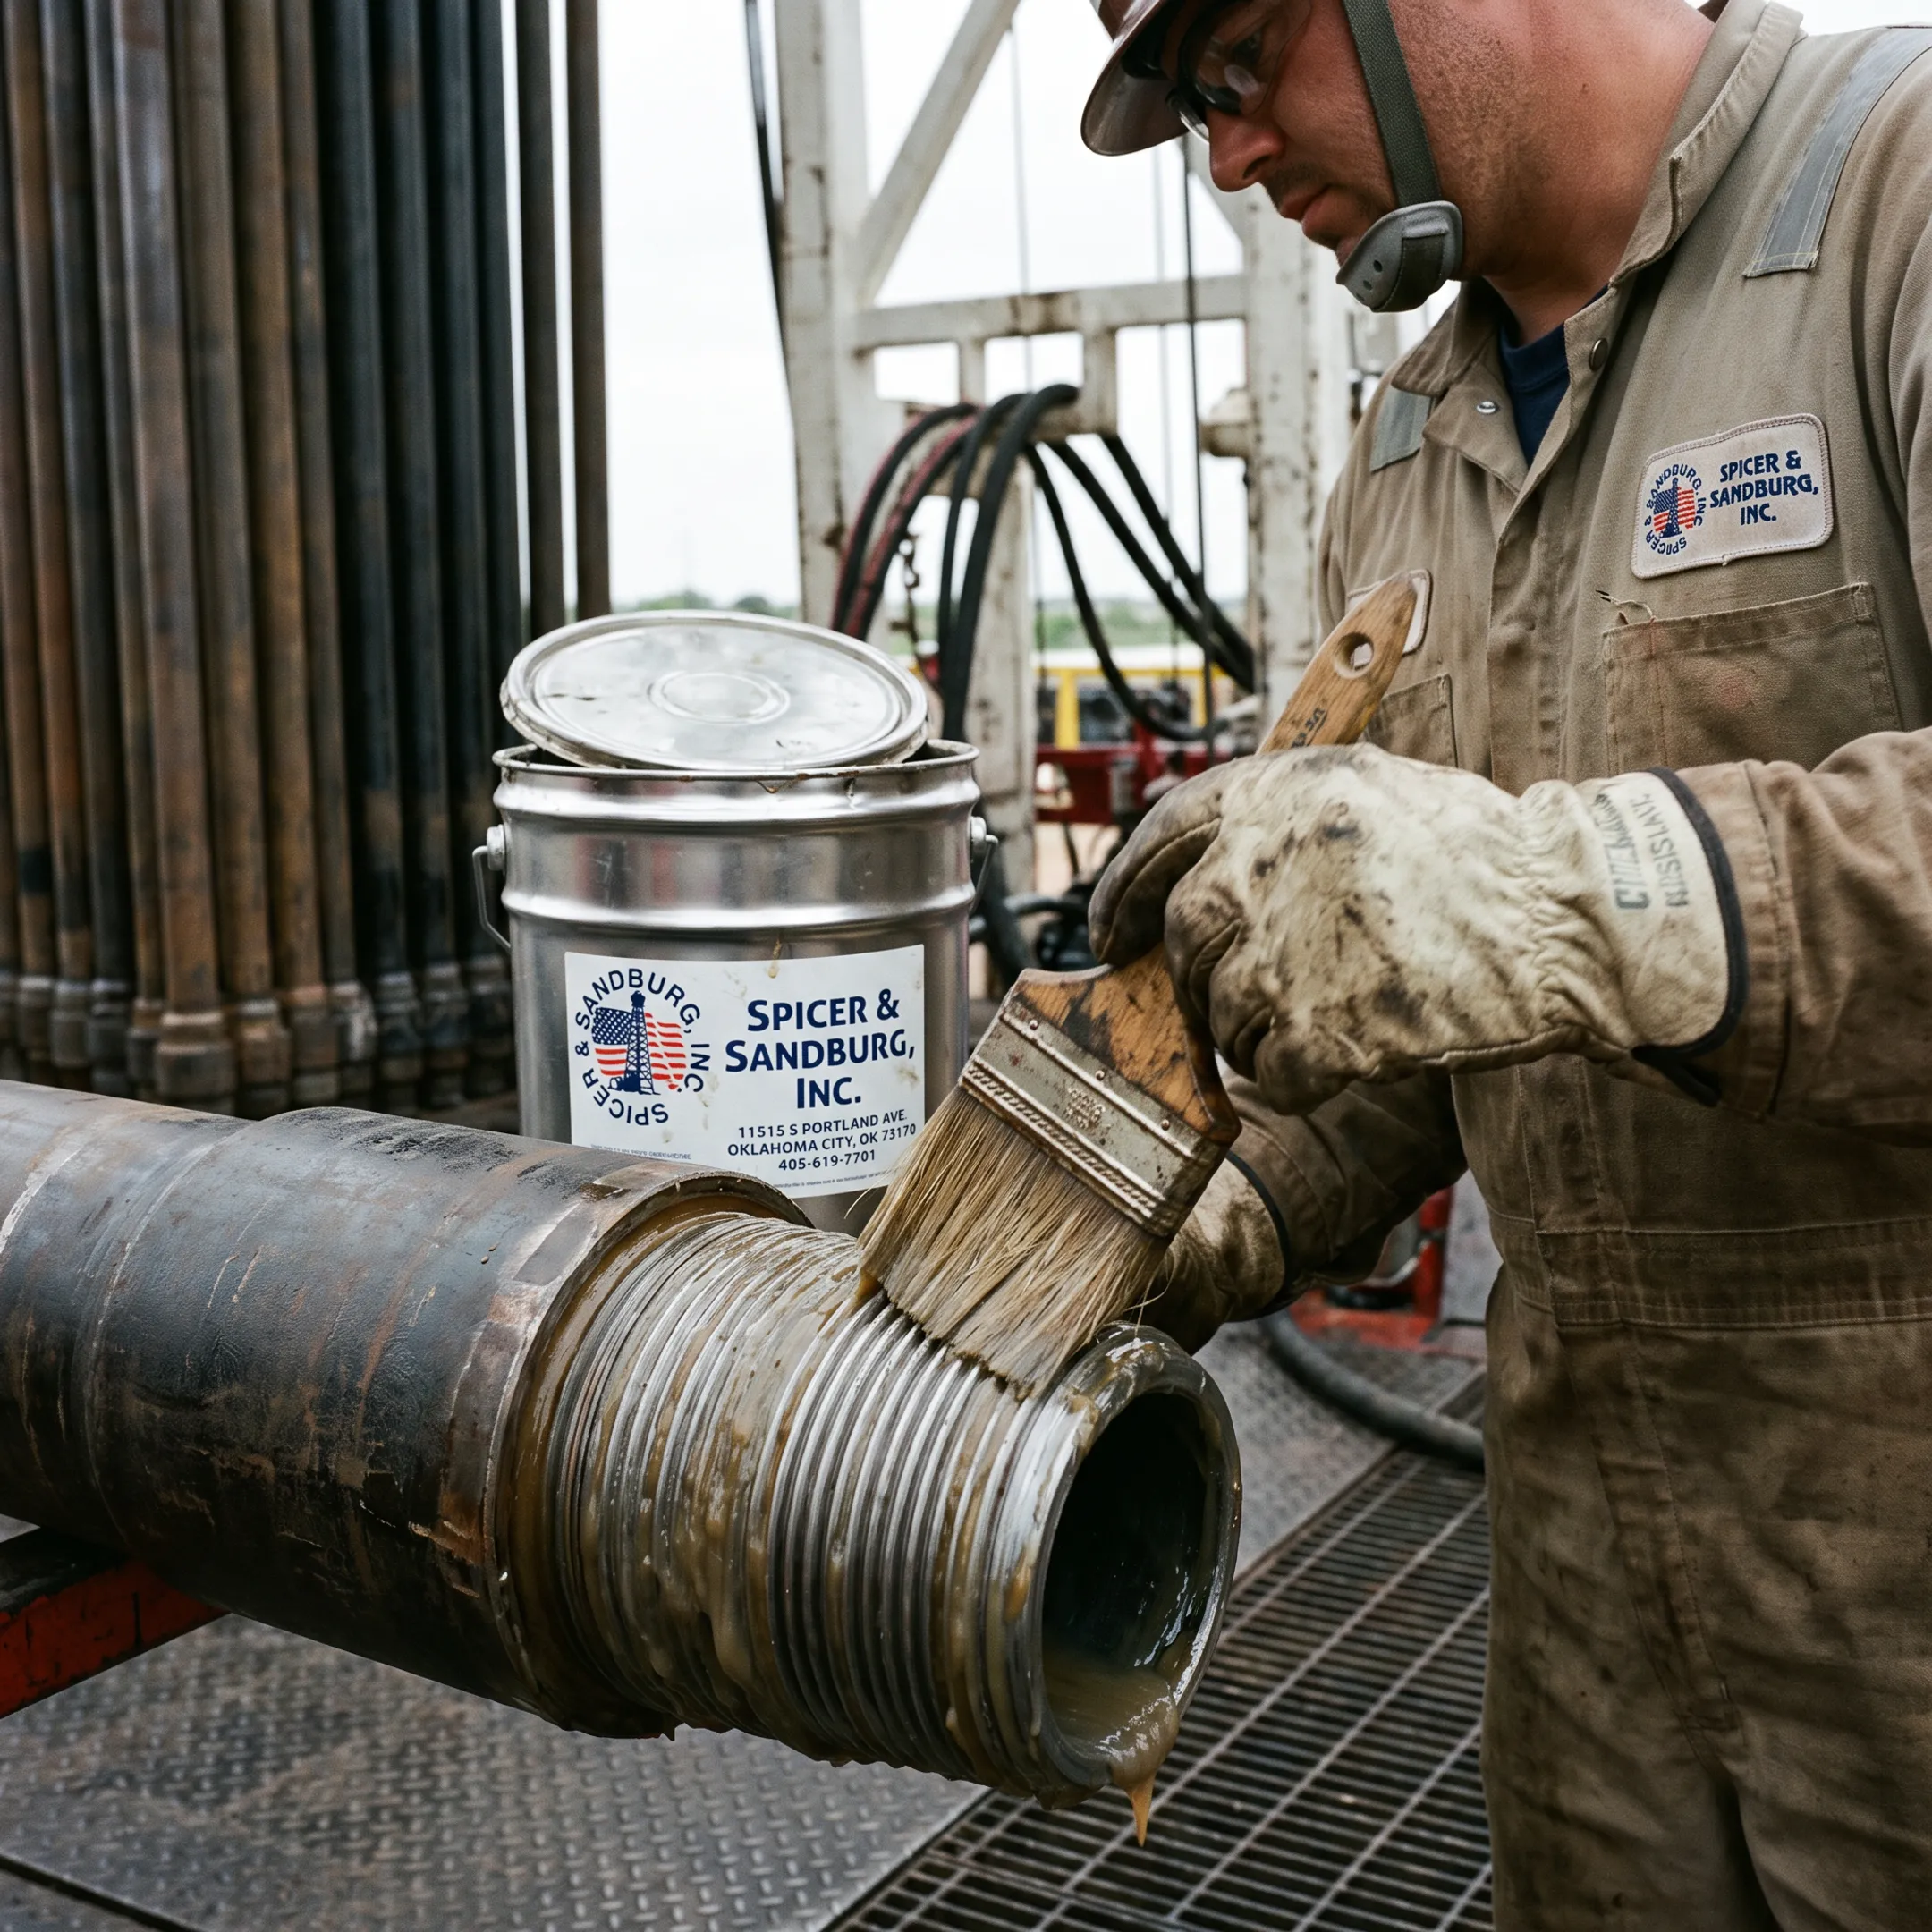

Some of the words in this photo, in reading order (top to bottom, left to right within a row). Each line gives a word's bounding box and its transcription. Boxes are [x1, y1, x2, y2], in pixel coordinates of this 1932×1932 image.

[1720, 453, 1780, 482] SPICER
[1785, 450, 1801, 470] &
[1710, 474, 1818, 508] SANDBURG,
[1741, 503, 1777, 525] INC.
[575, 968, 700, 1034] SANDBURG,
[747, 996, 868, 1031] SPICER
[877, 988, 900, 1021] &
[575, 1041, 589, 1056] &
[725, 1029, 915, 1072] SANDBURG,
[582, 1068, 669, 1126] SPICER
[797, 1077, 861, 1109] INC.
[727, 1140, 818, 1156] OKLAHOMA
[821, 1135, 856, 1150] CITY,
[860, 1131, 878, 1146] OK
[882, 1123, 917, 1141] 73170
[738, 1124, 785, 1138] 11515
[789, 1123, 798, 1136] S
[802, 1114, 878, 1134] PORTLAND
[882, 1109, 908, 1124] AVE.
[778, 1149, 876, 1171] 405-619-7701
